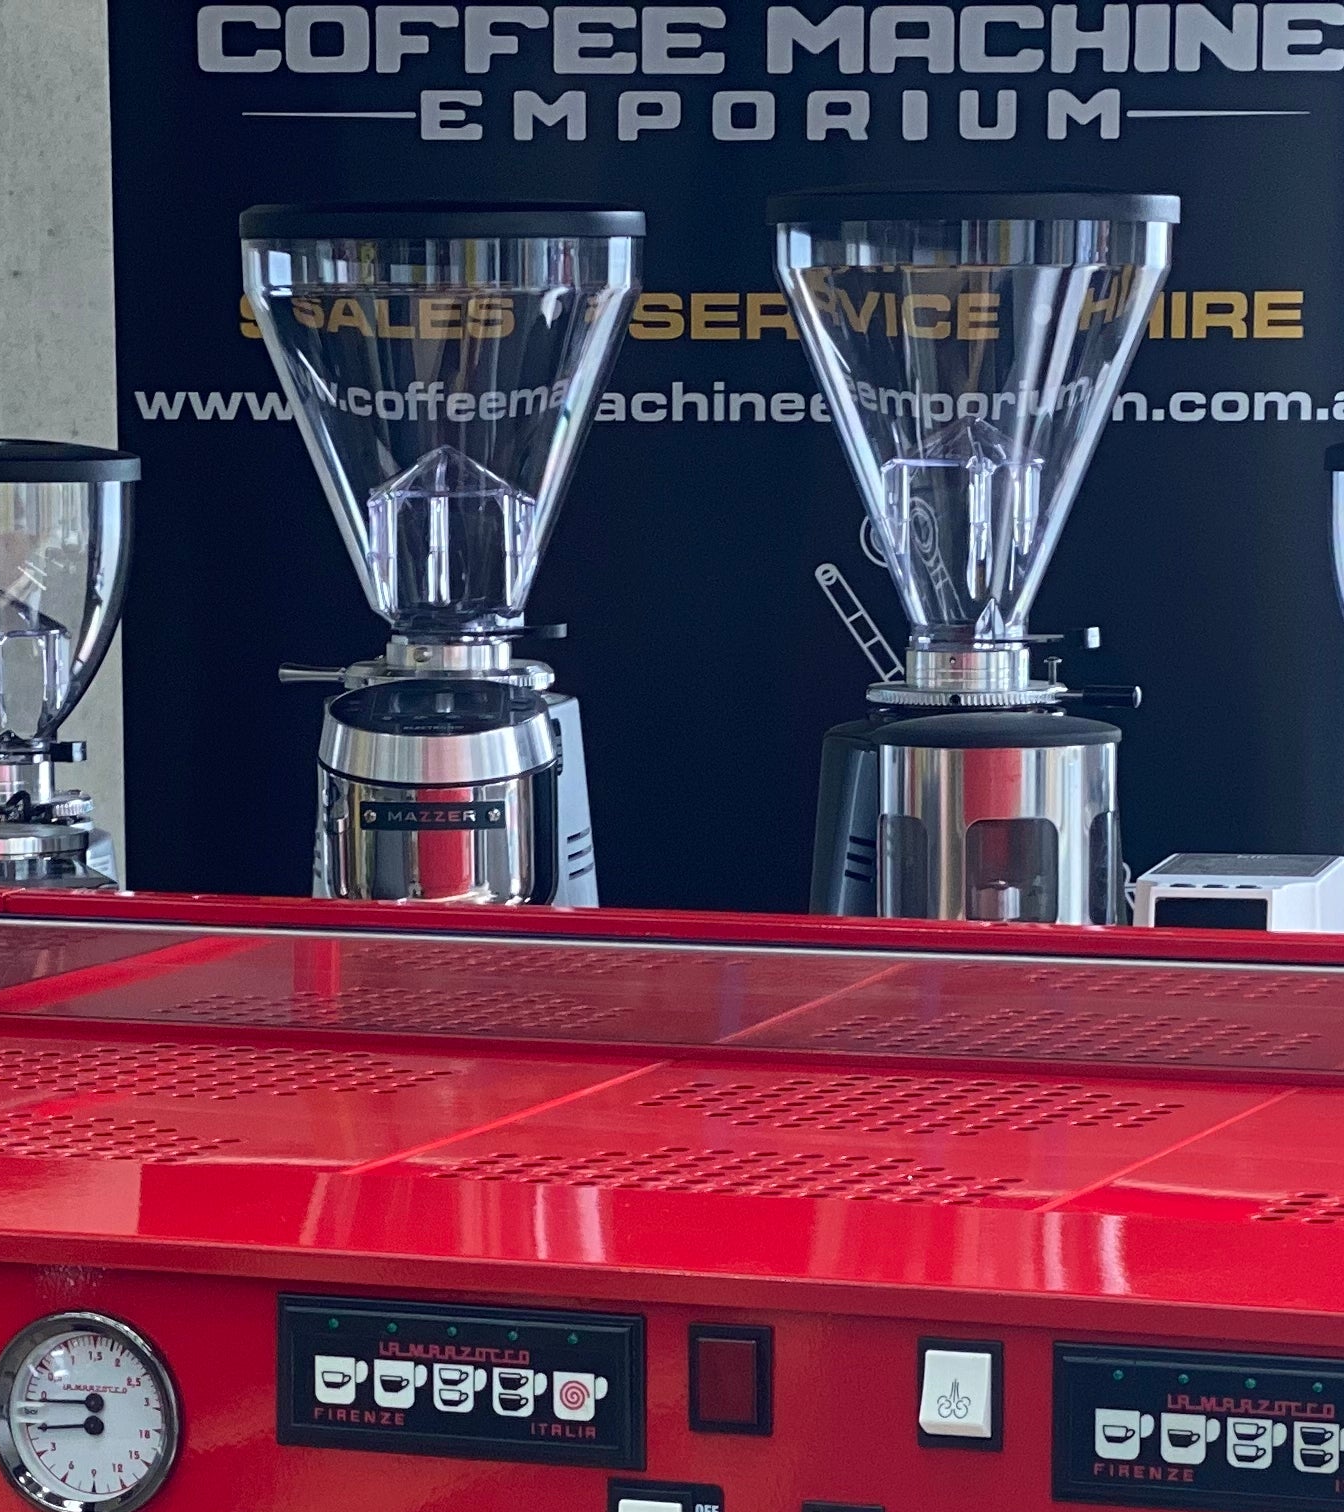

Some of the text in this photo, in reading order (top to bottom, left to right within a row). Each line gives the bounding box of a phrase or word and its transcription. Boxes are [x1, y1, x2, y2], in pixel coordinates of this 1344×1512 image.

[197, 5, 726, 76] COFFEE
[420, 90, 1121, 141] EMPORIUM
[240, 295, 515, 340] SALES
[629, 282, 1000, 340] SERVICE
[387, 809, 477, 823] MAZZER
[314, 1407, 406, 1426] FIRENZE
[530, 1422, 596, 1439] ITALIA
[129, 1450, 140, 1460] 15
[1093, 1463, 1194, 1482] FIRENZE
